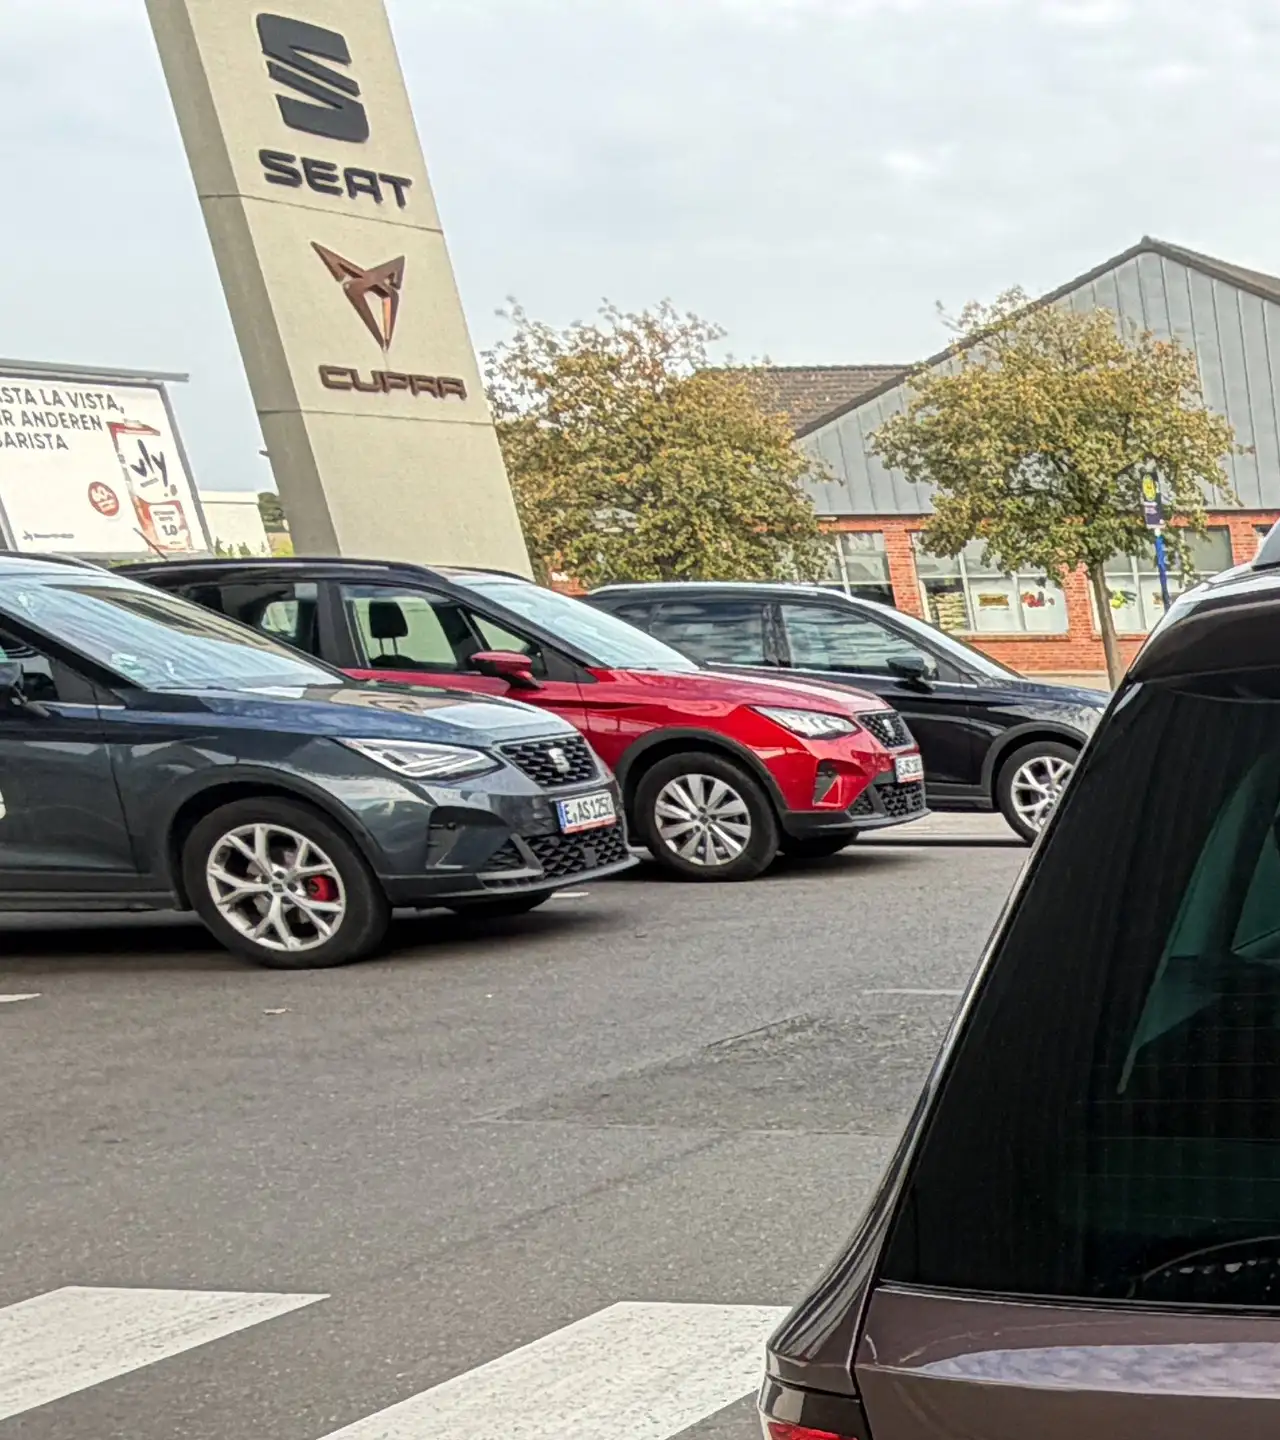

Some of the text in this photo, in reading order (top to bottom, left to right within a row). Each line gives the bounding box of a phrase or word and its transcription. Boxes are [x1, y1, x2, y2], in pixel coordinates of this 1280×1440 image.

[258, 148, 413, 209] SEAT
[318, 365, 468, 400] CUPRA
[39, 388, 66, 408] LA
[0, 409, 103, 431] R ANDEREN
